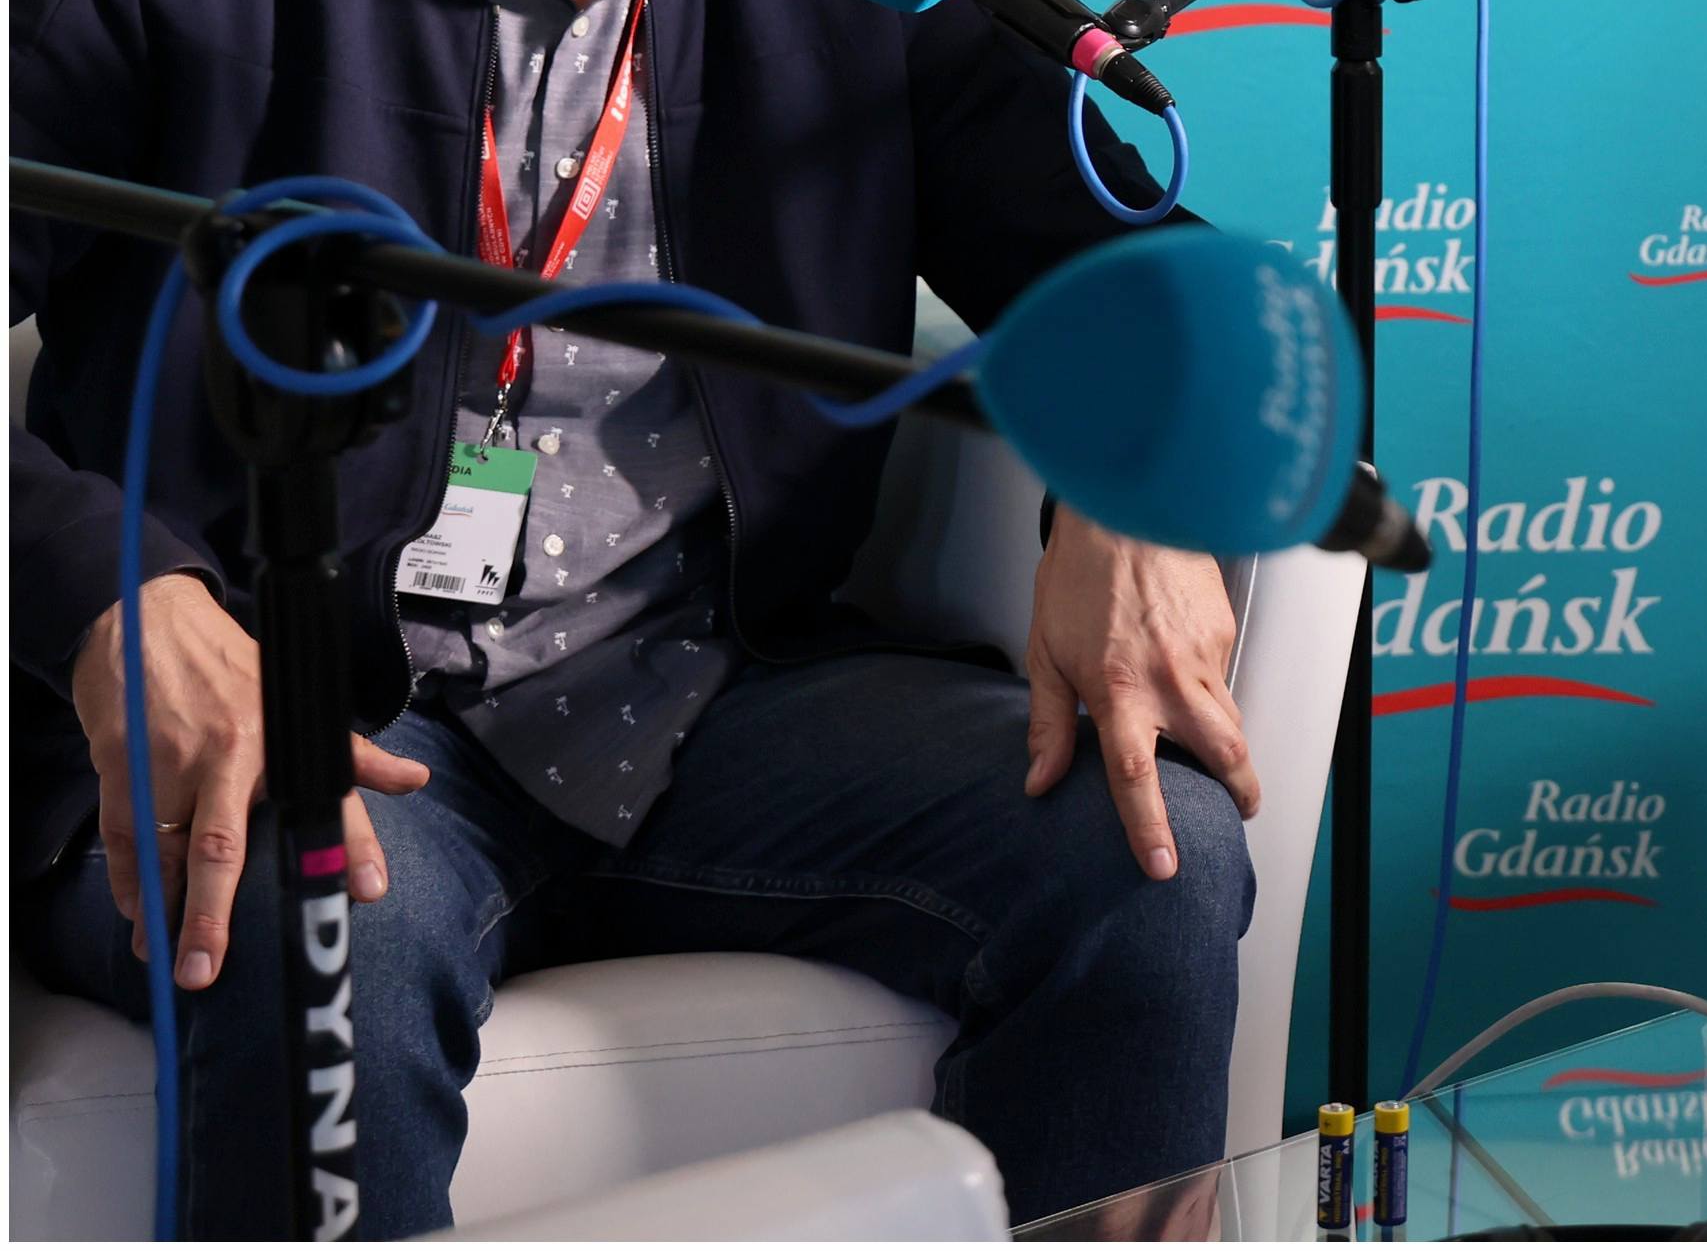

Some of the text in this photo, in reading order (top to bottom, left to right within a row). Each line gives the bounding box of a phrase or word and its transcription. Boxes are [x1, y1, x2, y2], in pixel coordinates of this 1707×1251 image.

[450, 464, 473, 476] DIA
[1412, 475, 1663, 554] Radio
[1372, 567, 1662, 658] dańsk
[1525, 778, 1666, 824] Radio
[1452, 829, 1664, 879] Gdańsk
[1342, 1138, 1350, 1155] AA
[1319, 1144, 1333, 1204] VARTA
